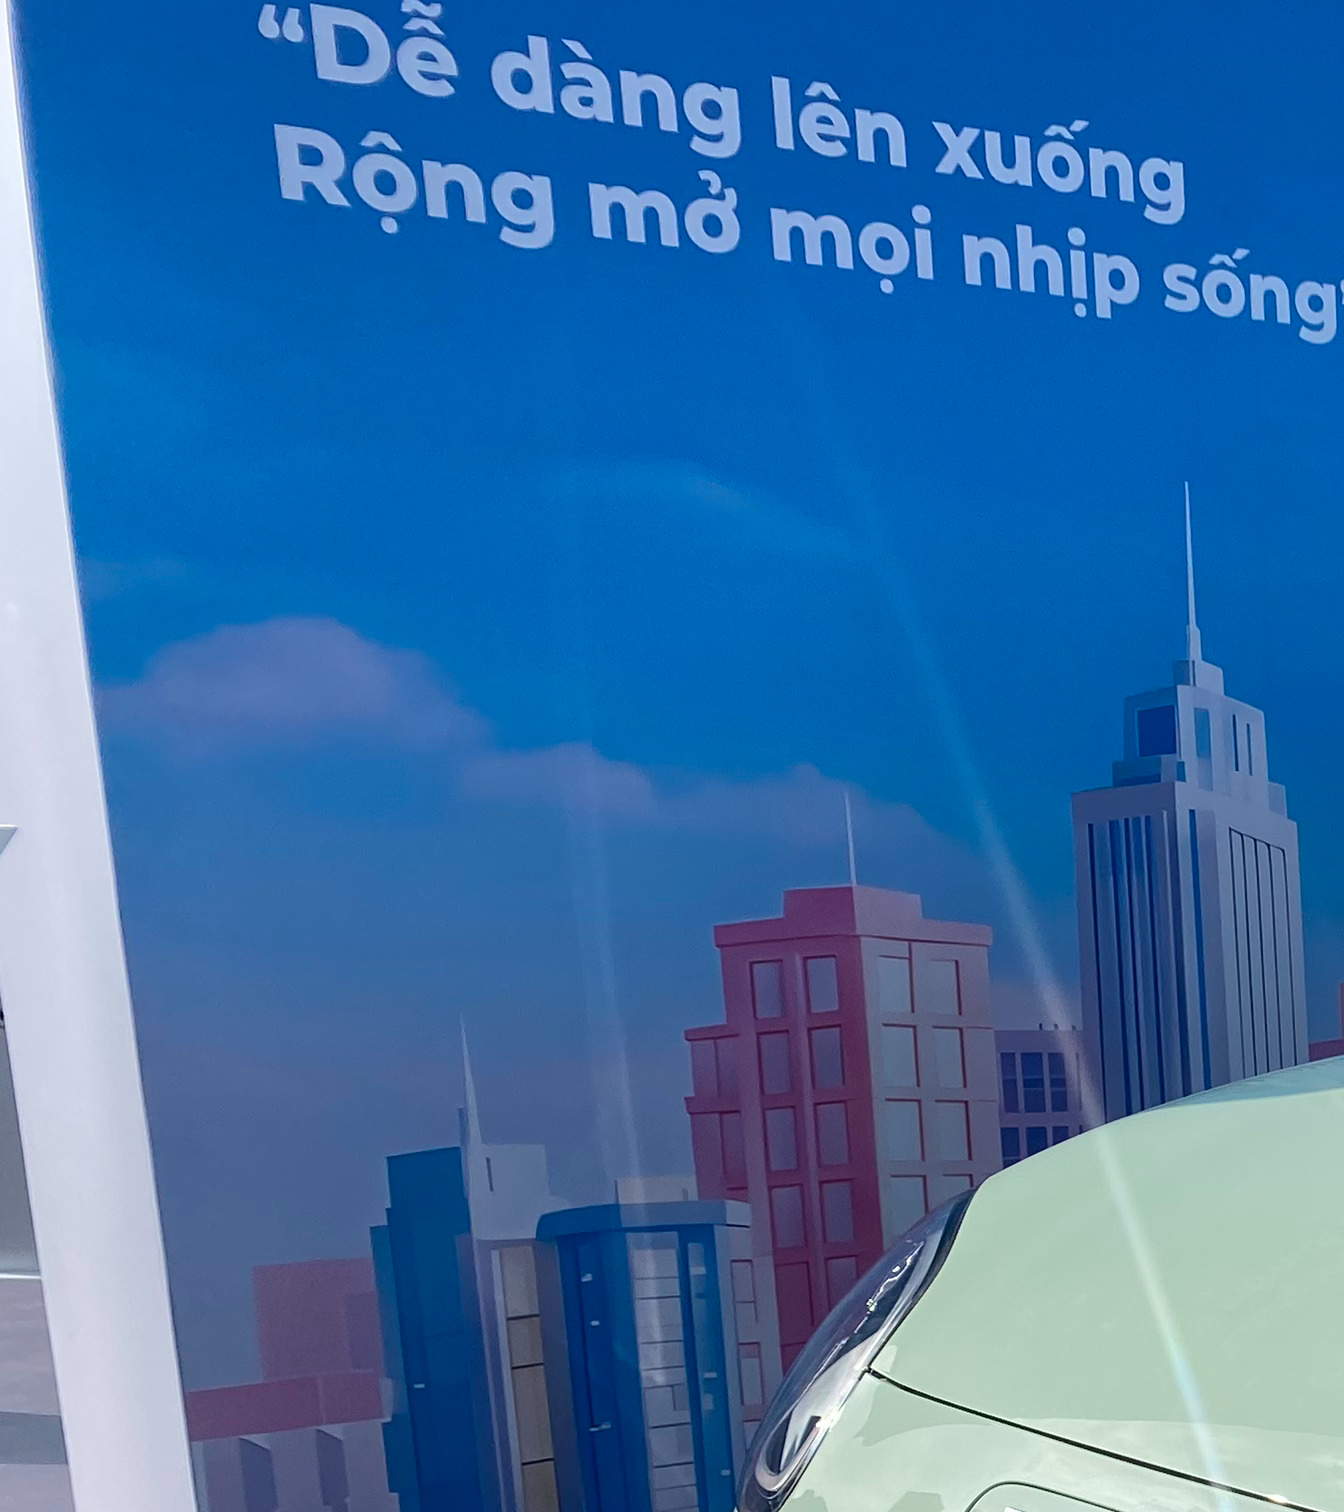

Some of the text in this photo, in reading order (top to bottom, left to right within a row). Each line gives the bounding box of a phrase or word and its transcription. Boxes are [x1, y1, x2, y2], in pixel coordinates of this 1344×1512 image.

[273, 123, 555, 249] Rộng
[588, 169, 741, 254] mở
[769, 204, 934, 294] mọi
[962, 223, 1140, 319] nhịp
[490, 36, 742, 159] dàng
[771, 76, 907, 168] lên
[931, 119, 1186, 225] xuống
